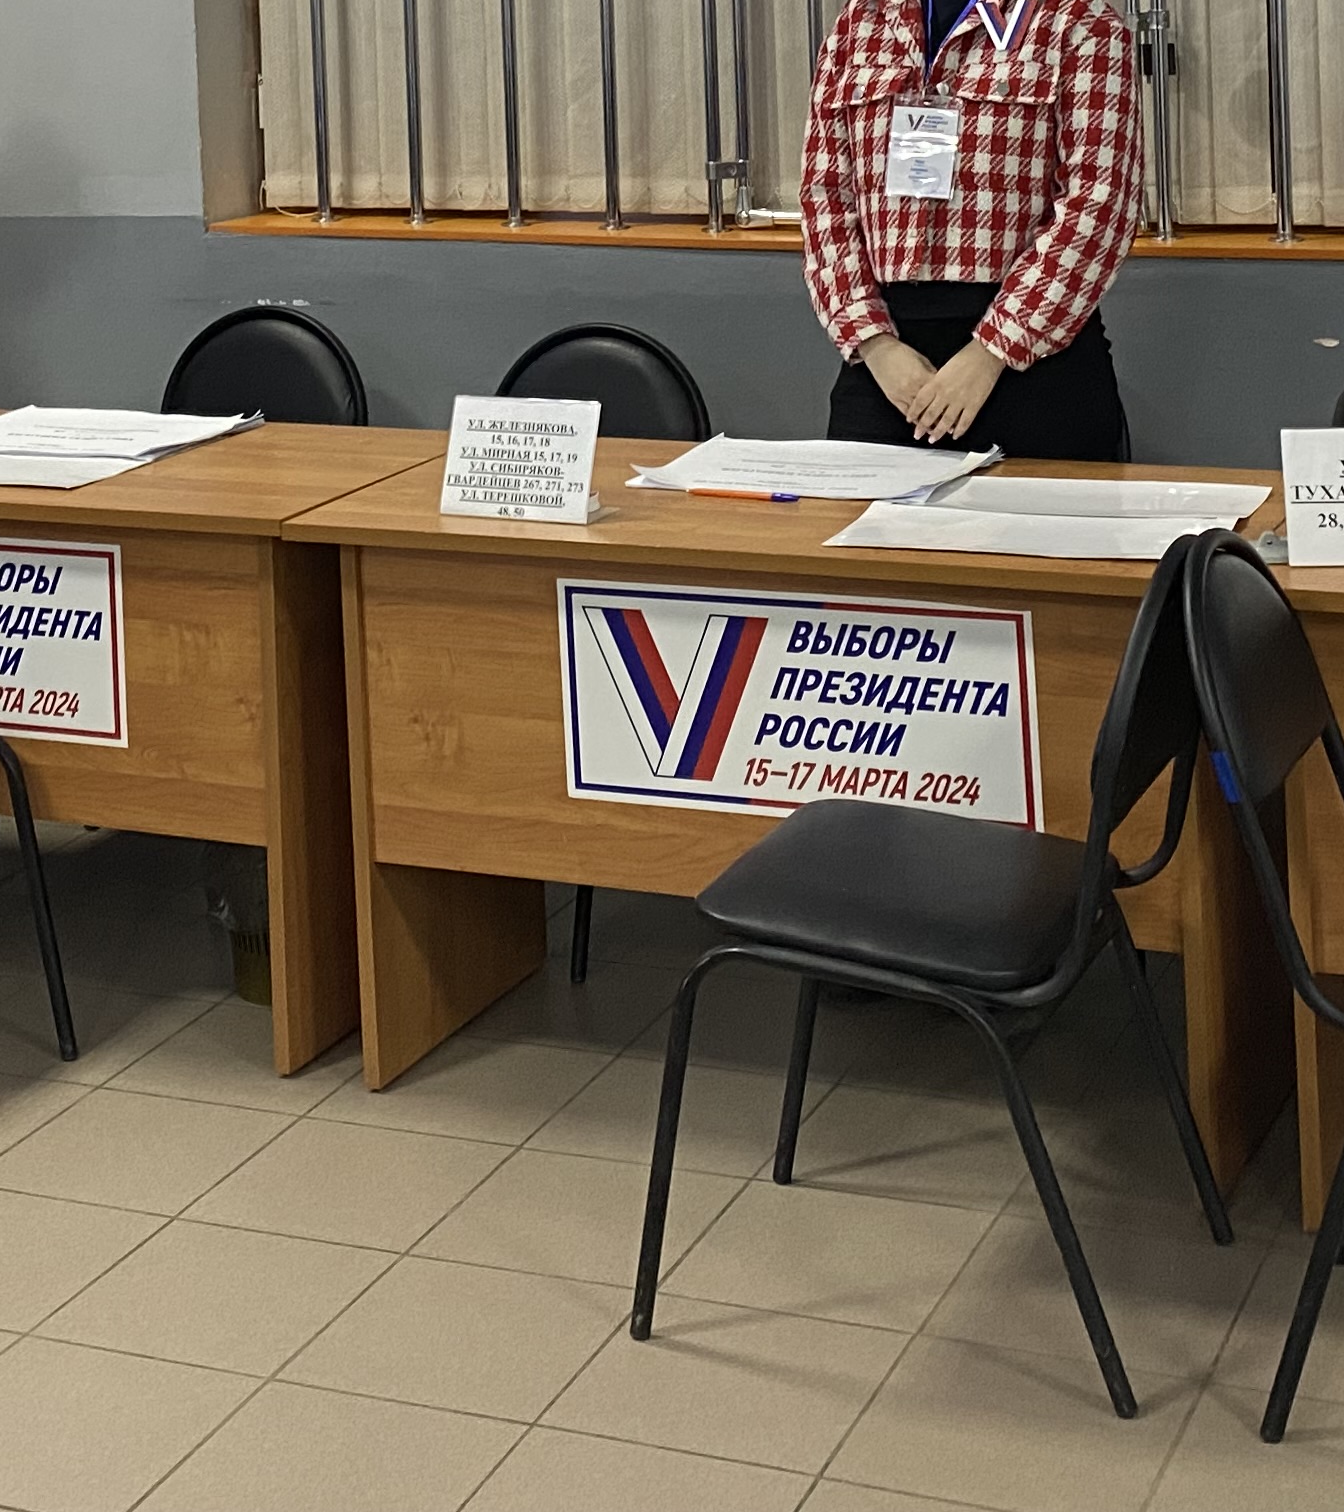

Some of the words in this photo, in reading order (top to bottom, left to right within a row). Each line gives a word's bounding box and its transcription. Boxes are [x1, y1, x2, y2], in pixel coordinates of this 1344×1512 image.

[468, 419, 486, 431] УЛ.
[491, 435, 504, 445] 15,
[508, 435, 521, 446] 16,
[524, 436, 537, 447] 17,
[540, 437, 550, 447] 18
[461, 447, 478, 458] УЛ.
[482, 448, 530, 460] МИРНАЯ
[534, 451, 547, 462] 15,
[550, 452, 563, 463] 17,
[567, 453, 578, 463] 19
[469, 461, 486, 472] УЛ.
[447, 474, 520, 489] ГВАРДЕЙЦЕВ
[523, 478, 542, 490] 267,
[546, 480, 564, 492] 271,
[567, 481, 583, 492] 273
[461, 489, 479, 501] УЛ.
[514, 507, 524, 517] 50
[1317, 513, 1344, 530] 28,
[786, 621, 956, 664] ВЫБОРЫ
[770, 668, 1010, 717] ПРЕЗИДЕНТА
[29, 689, 80, 718] 2024
[755, 716, 907, 757] РОССИИ
[820, 764, 910, 801] МАРТА
[914, 772, 982, 806] 2024
